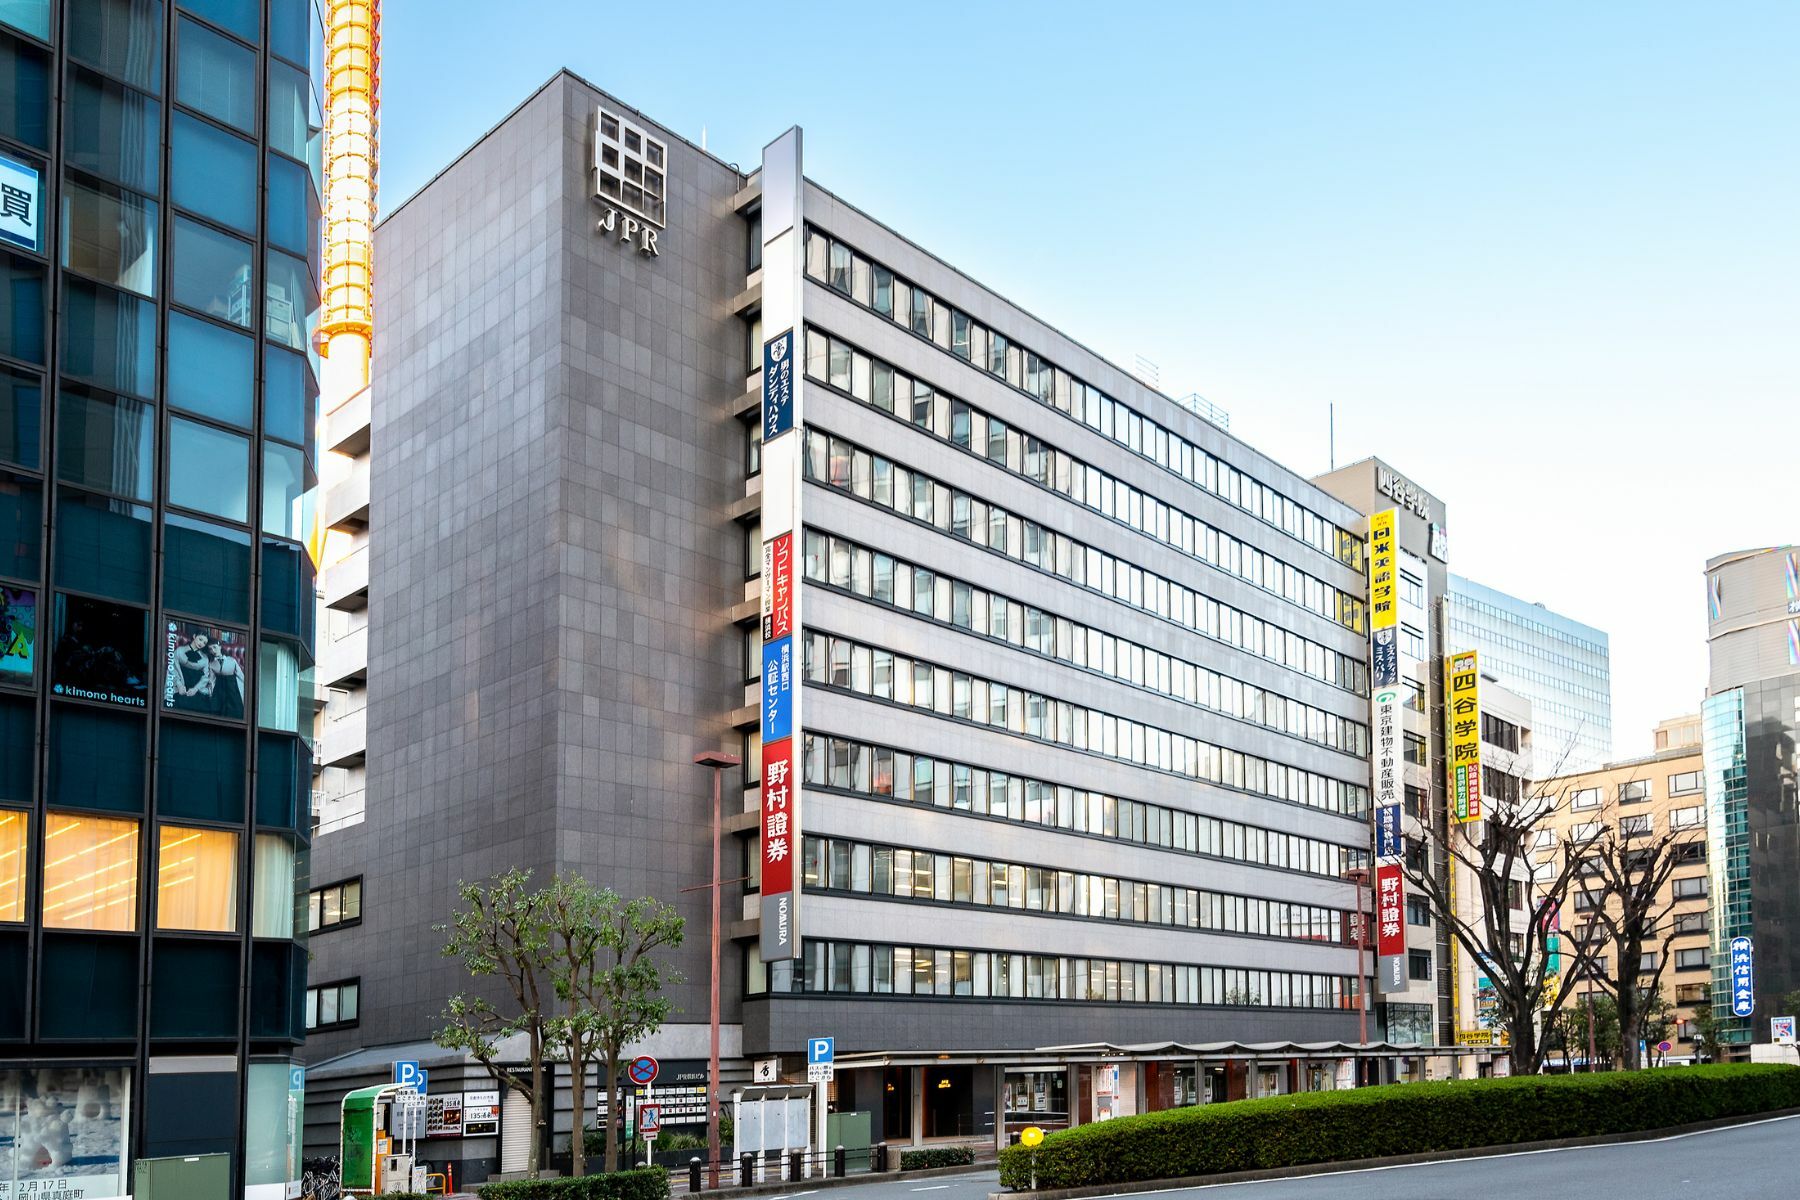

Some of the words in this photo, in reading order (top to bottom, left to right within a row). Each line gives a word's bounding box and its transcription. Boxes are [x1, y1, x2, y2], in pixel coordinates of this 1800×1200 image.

[0, 182, 32, 227] 買
[598, 208, 660, 257] JPR
[768, 364, 778, 436] ダンディハウス
[780, 358, 790, 406] 男のエステ
[167, 632, 177, 673] kimono
[781, 644, 790, 692] 横浜駅西口
[65, 685, 108, 701] kimono
[110, 693, 145, 708] hearts
[167, 675, 175, 708] hearts
[767, 659, 778, 734] 公証センター
[1453, 673, 1478, 762] 四谷学院
[1380, 704, 1395, 800] 東京建物不動産販売
[767, 759, 789, 864] 野村證券
[779, 897, 788, 946] NOMURA
[1381, 876, 1400, 938] 野村證券
[1393, 957, 1401, 986] NOMURA
[1732, 940, 1751, 1012] 横浜信用金庫
[402, 1063, 415, 1084] P
[814, 1041, 829, 1061] P
